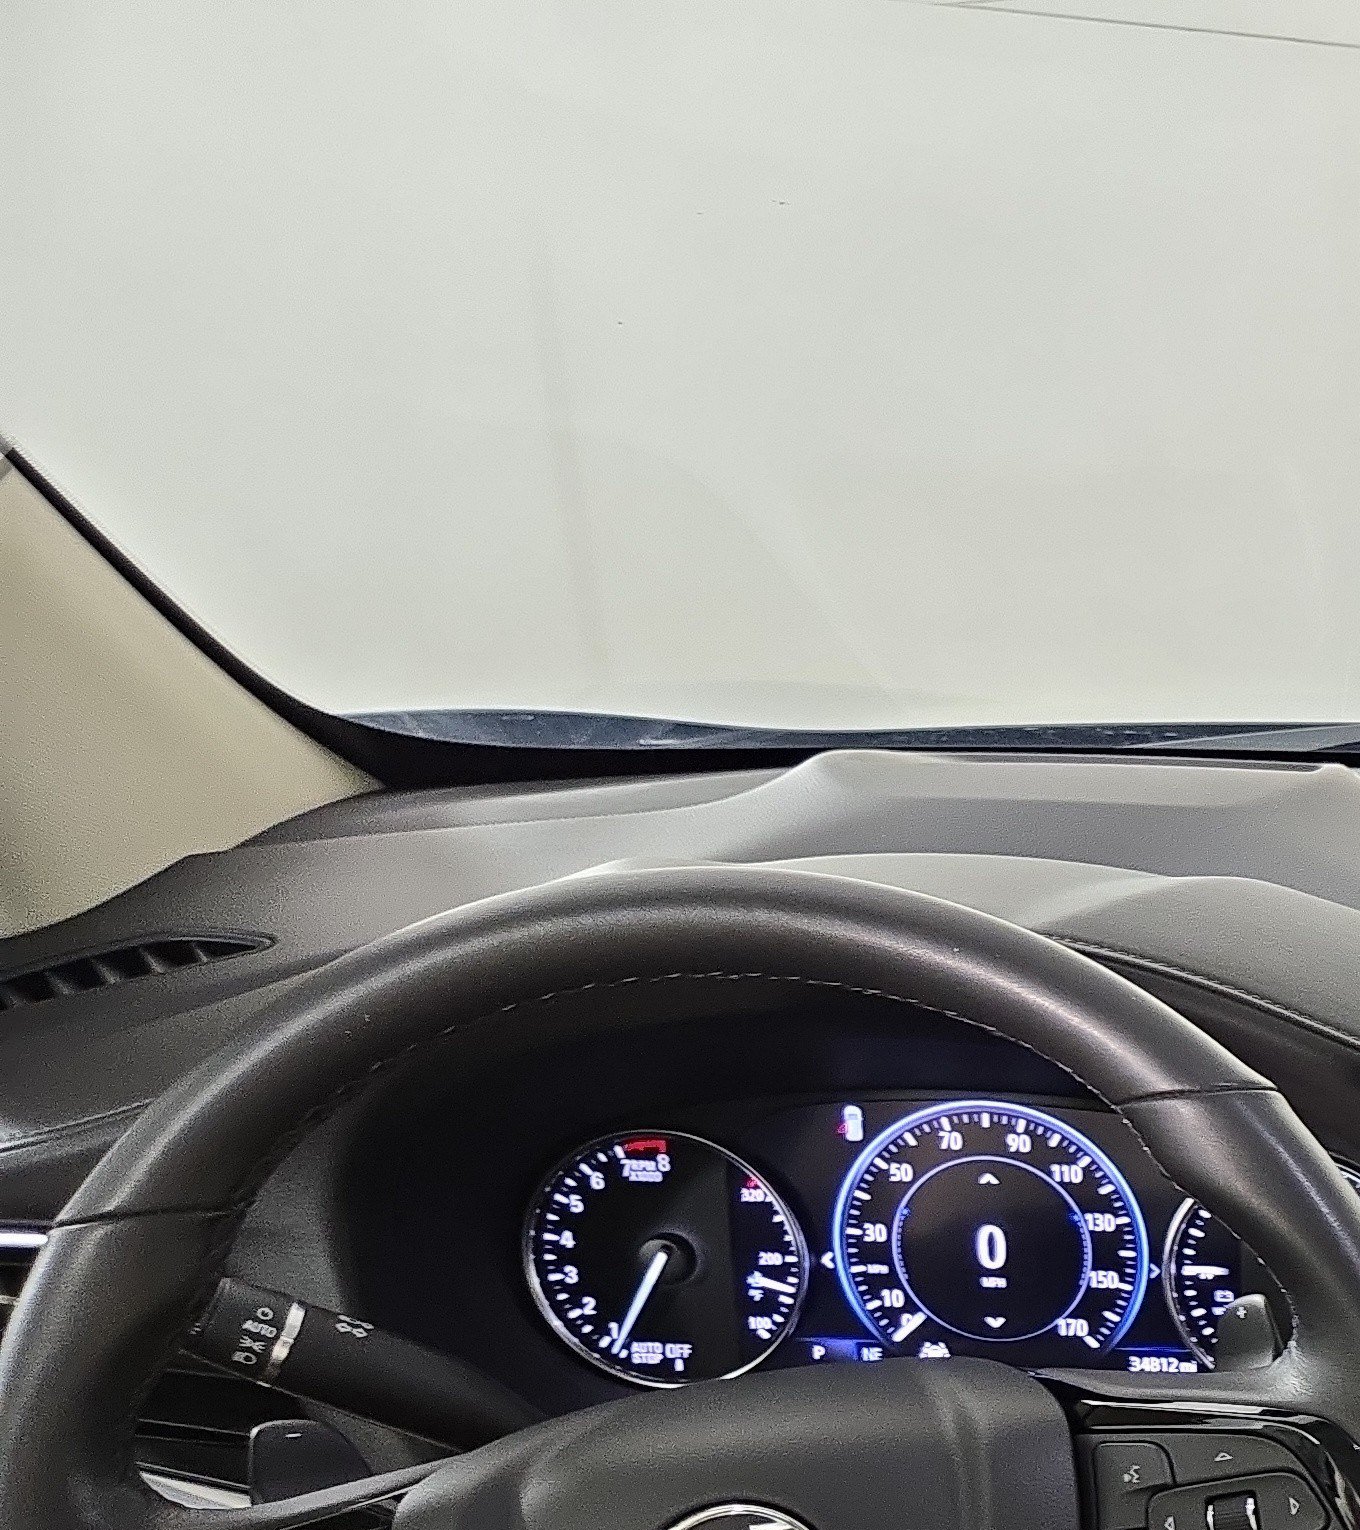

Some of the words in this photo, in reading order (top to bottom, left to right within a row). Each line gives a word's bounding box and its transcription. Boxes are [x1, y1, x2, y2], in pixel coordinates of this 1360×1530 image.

[939, 1132, 963, 1150] 70
[1005, 1134, 1032, 1153] 90
[620, 1159, 631, 1177] 7
[656, 1153, 671, 1172] 8
[590, 1171, 605, 1190] 6
[889, 1163, 914, 1182] 50
[1052, 1164, 1084, 1184] 110
[569, 1194, 585, 1213] 5
[1085, 1213, 1116, 1232] 130
[559, 1230, 576, 1248] 4
[862, 1224, 887, 1242] 30
[976, 1225, 1007, 1269] 0
[563, 1265, 579, 1284] 3
[1088, 1271, 1119, 1289] 150
[582, 1296, 597, 1315] 2
[881, 1289, 905, 1307] 10
[608, 1321, 619, 1339] 1
[1058, 1318, 1089, 1337] 170
[665, 1343, 693, 1359] OFF
[812, 1345, 826, 1360] P
